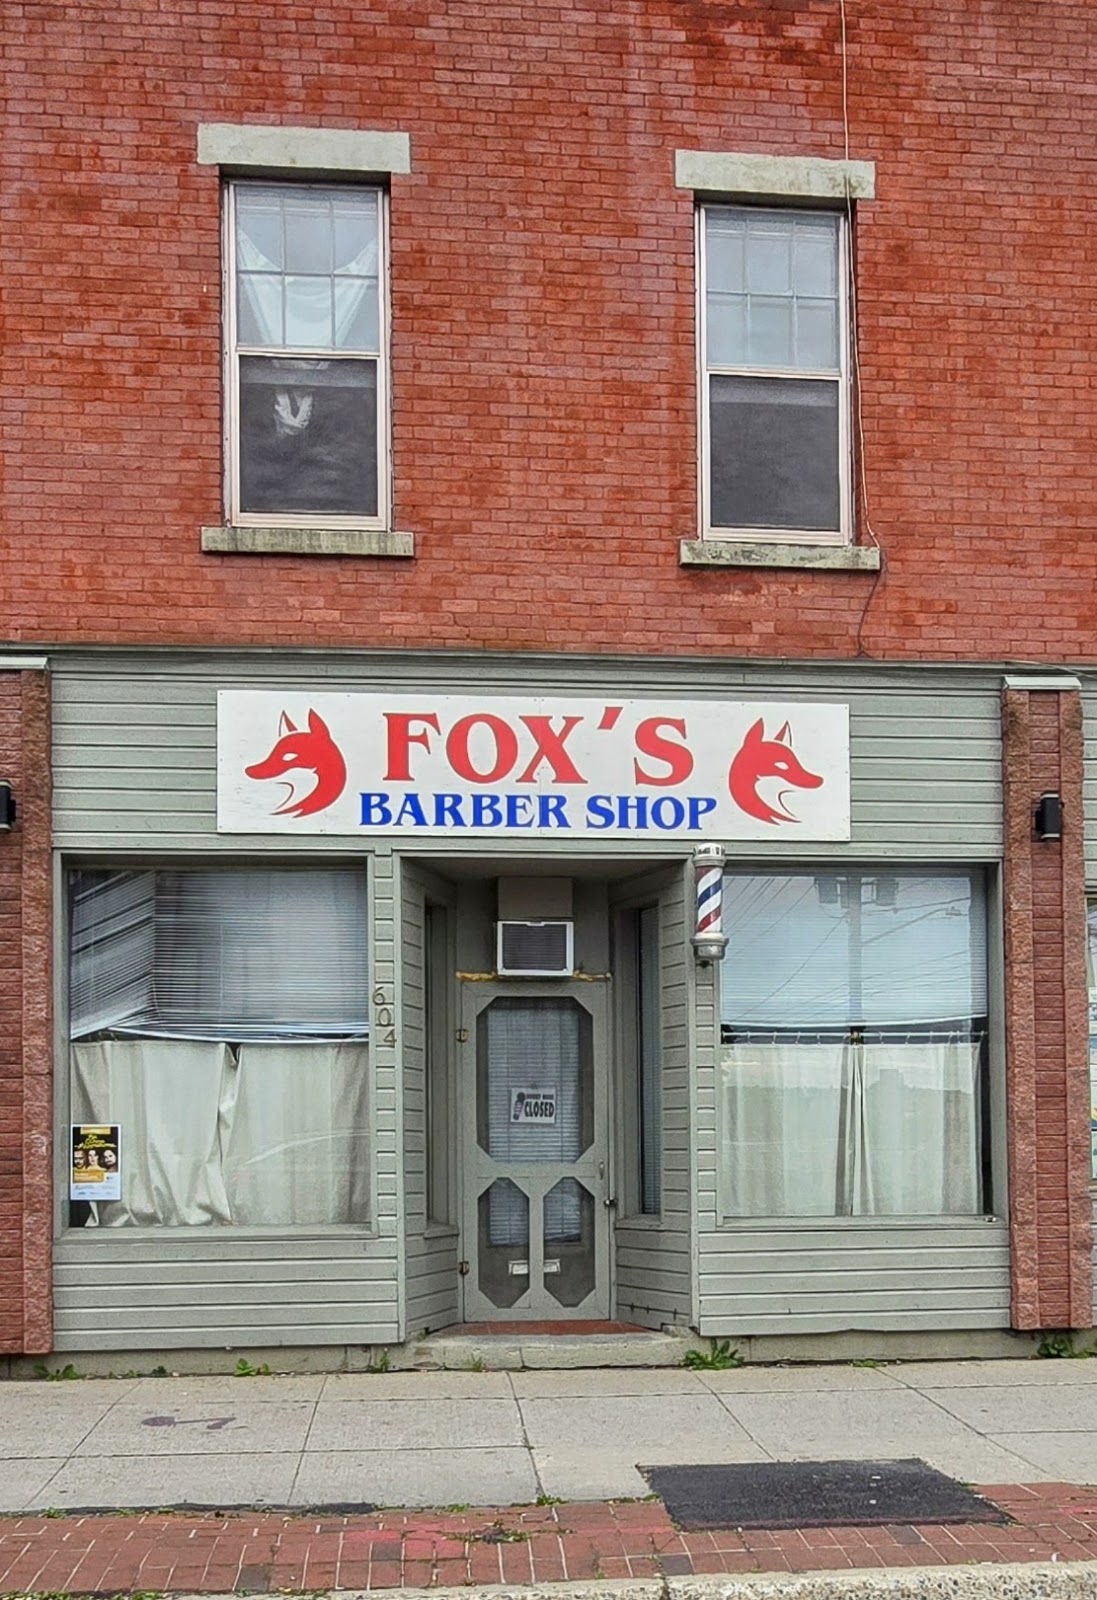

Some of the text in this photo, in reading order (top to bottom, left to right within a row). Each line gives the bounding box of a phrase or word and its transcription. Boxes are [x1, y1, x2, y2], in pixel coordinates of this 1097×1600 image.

[383, 706, 694, 786] FOX'S
[359, 791, 719, 831] BARBER SHOP
[372, 986, 397, 1048] 604
[524, 1101, 554, 1117] CLOSED
